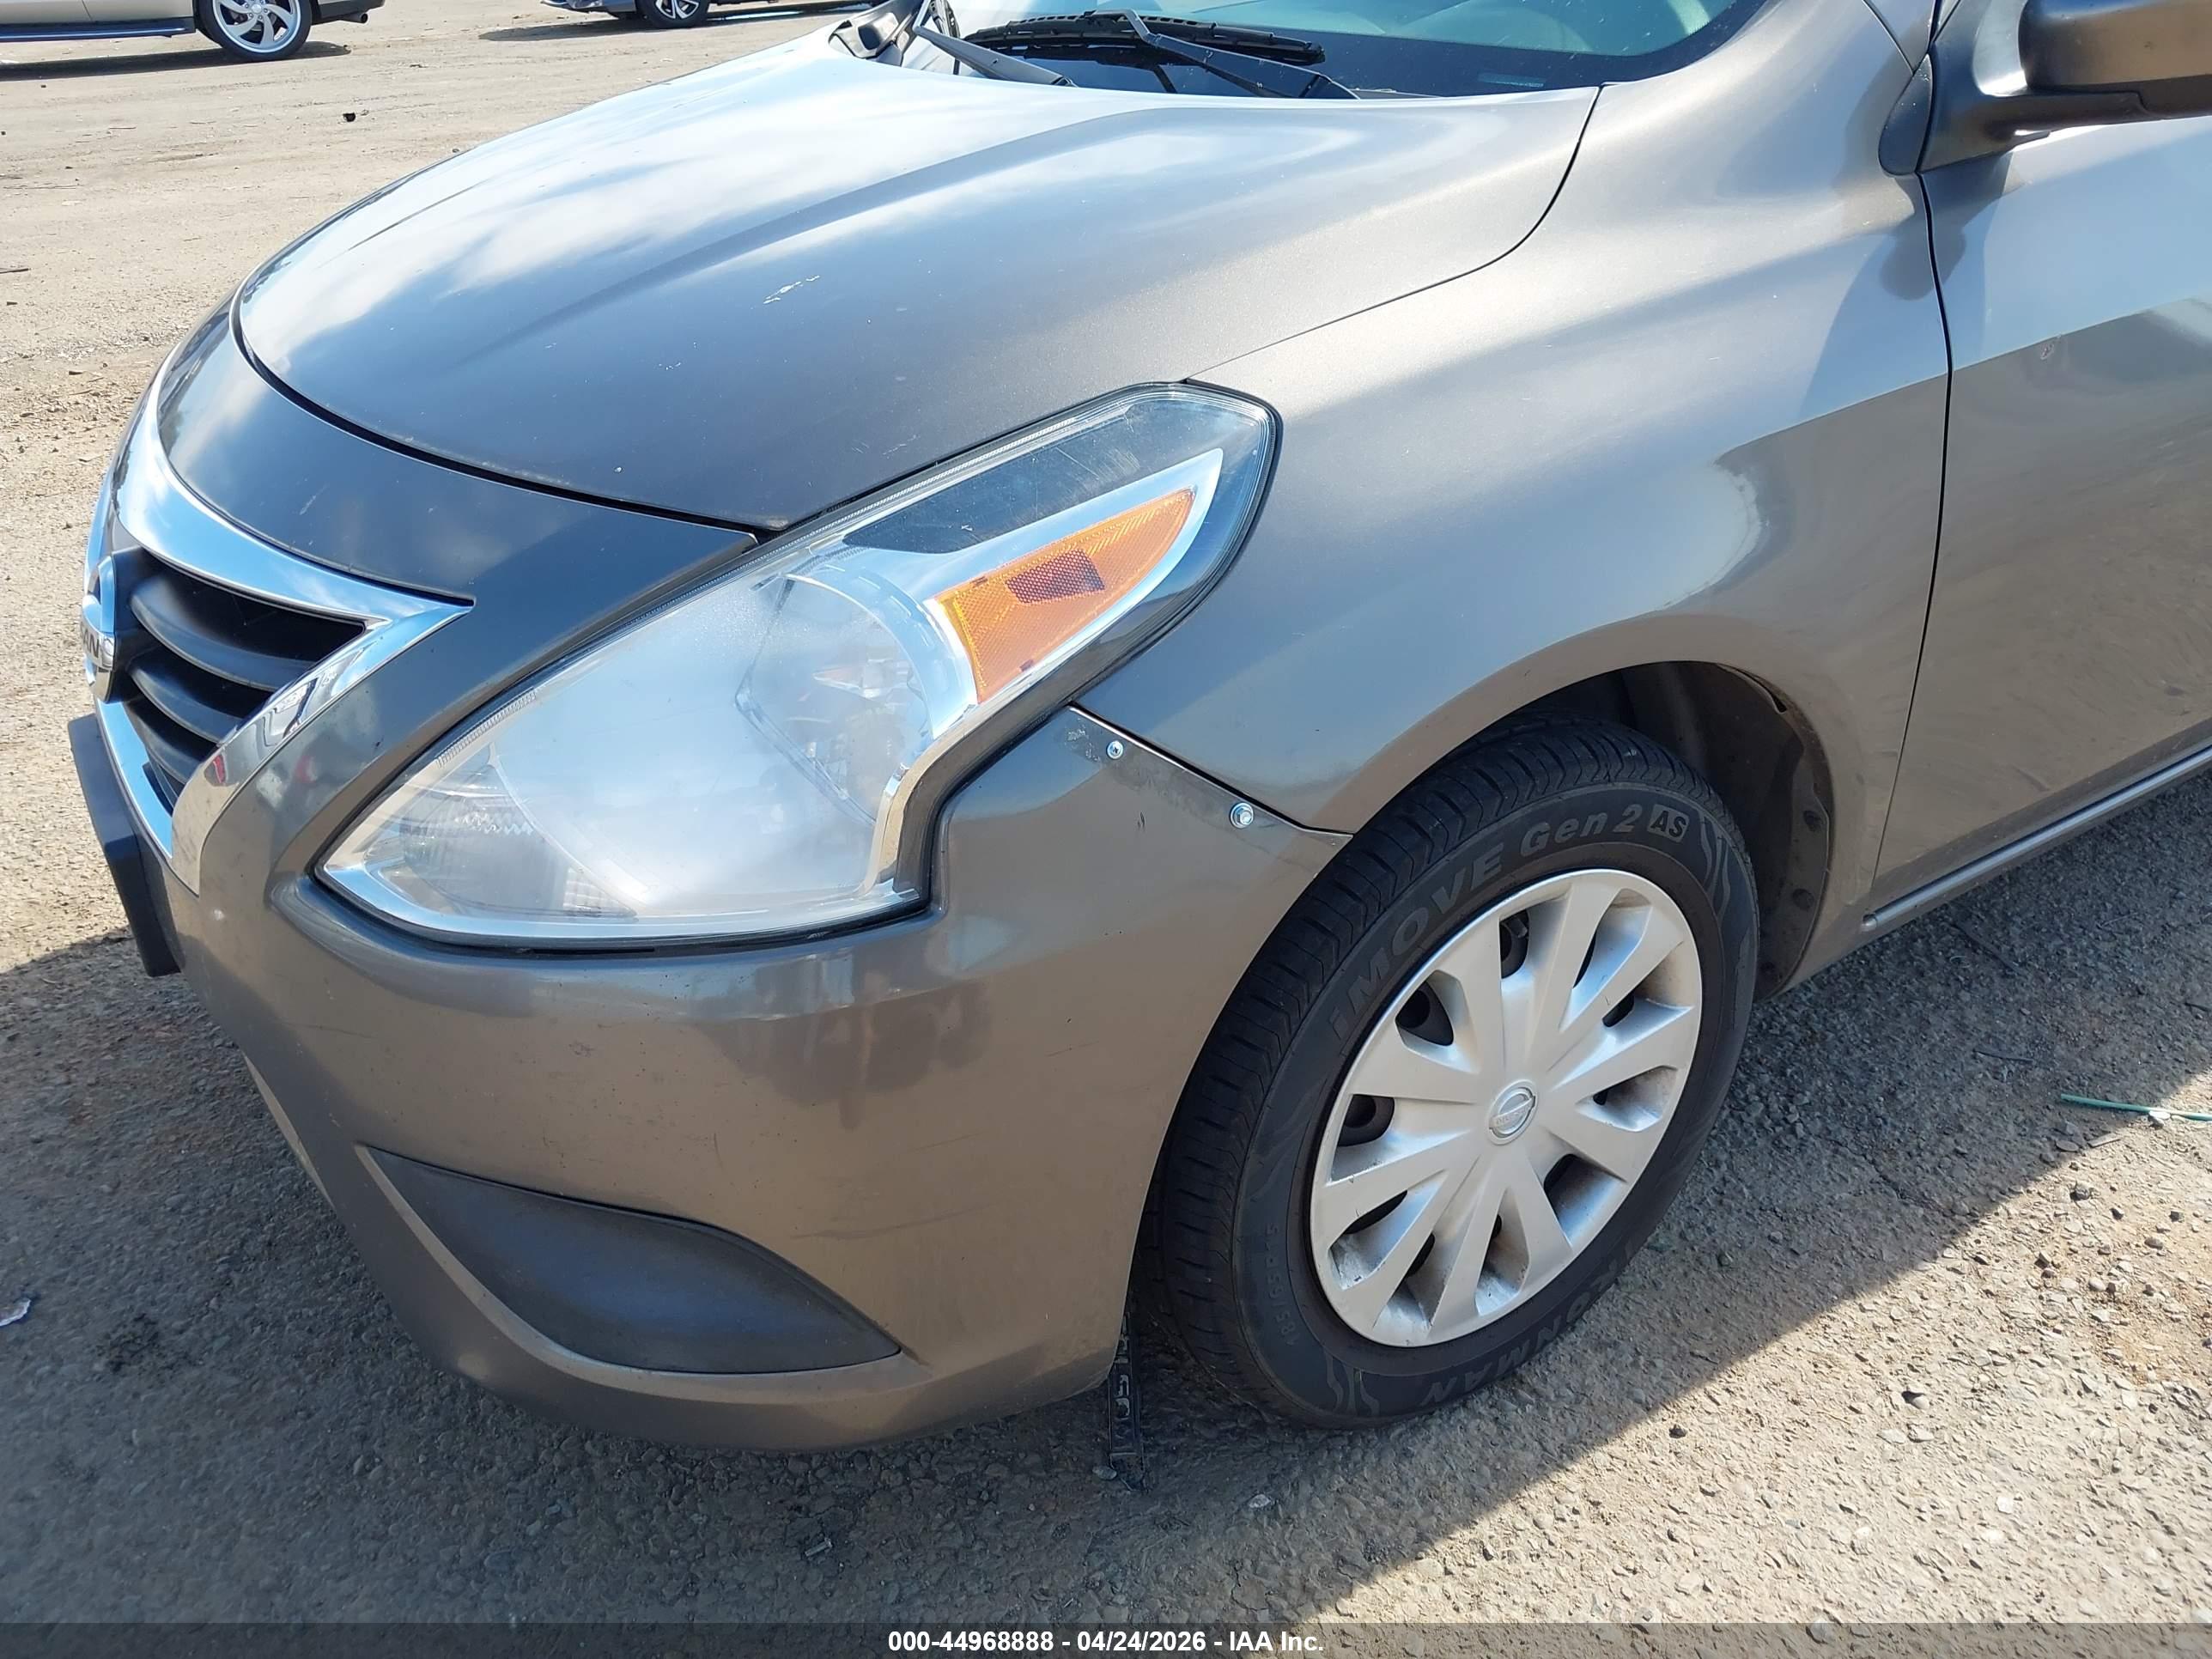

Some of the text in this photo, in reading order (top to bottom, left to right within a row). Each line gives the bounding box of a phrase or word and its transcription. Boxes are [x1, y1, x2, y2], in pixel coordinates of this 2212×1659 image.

[1519, 810, 1607, 857] Gen
[1612, 804, 1643, 835] 2
[1652, 810, 1688, 841] AS
